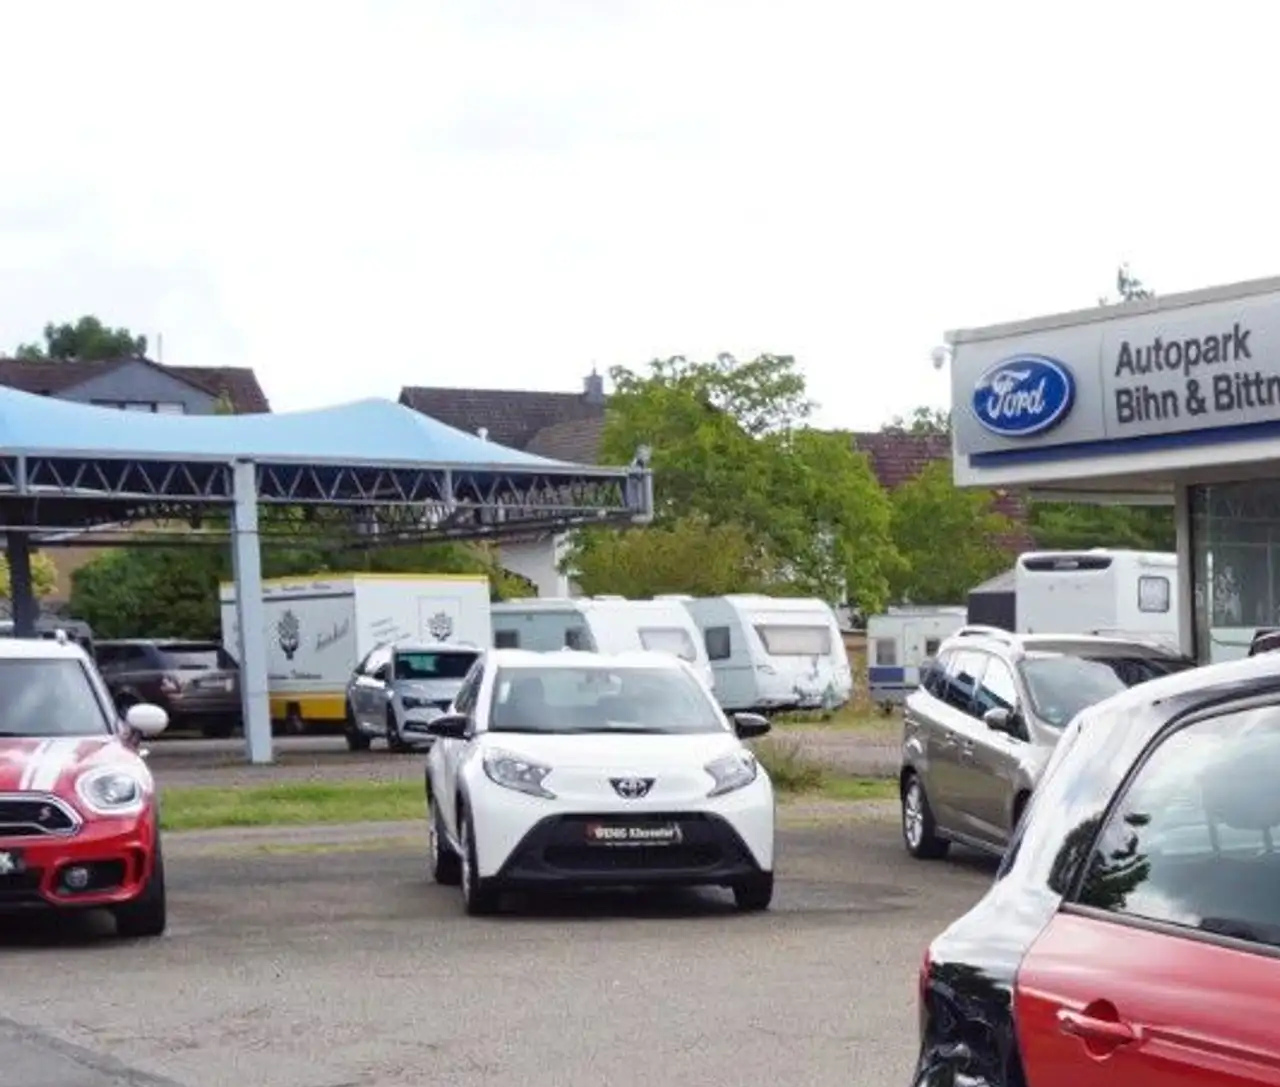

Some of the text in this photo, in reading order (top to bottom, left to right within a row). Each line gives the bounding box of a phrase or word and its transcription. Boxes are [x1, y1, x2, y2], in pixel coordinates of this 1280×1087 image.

[1114, 323, 1252, 377] Autopark
[986, 369, 1045, 419] Ford
[1114, 381, 1179, 424] Bihn
[1186, 379, 1207, 415] &
